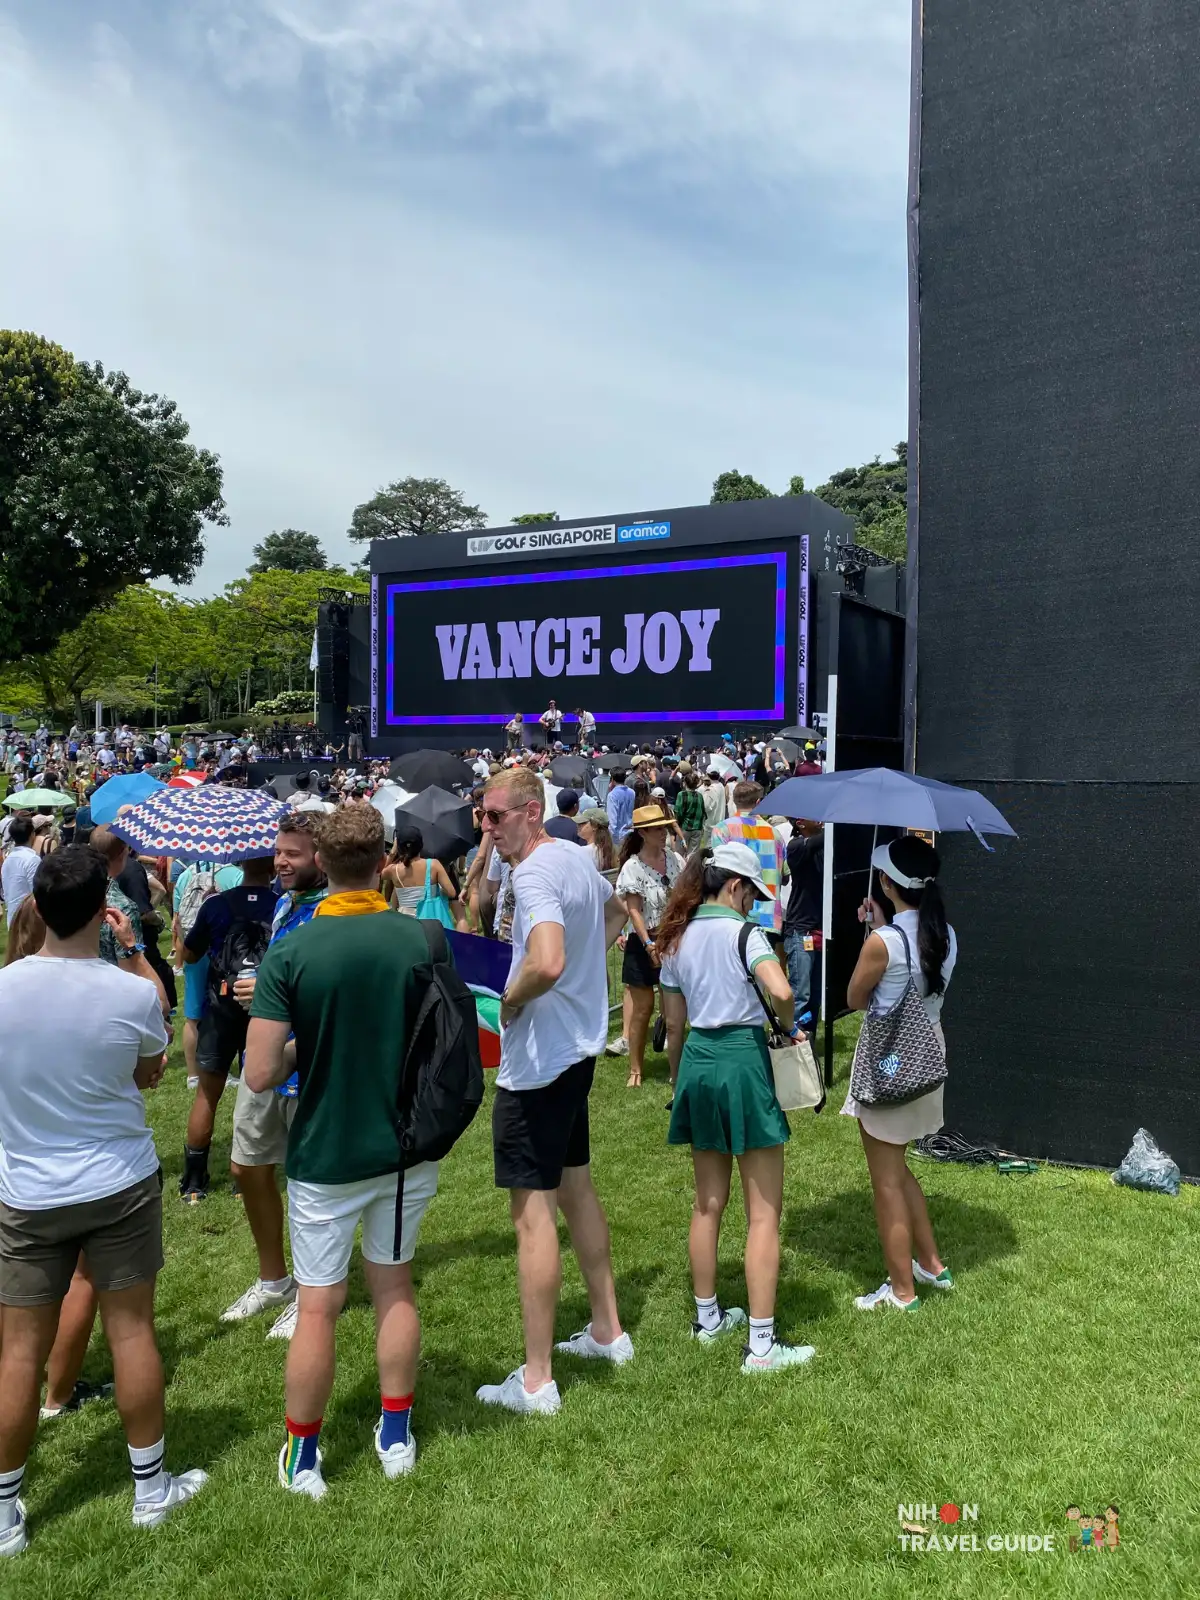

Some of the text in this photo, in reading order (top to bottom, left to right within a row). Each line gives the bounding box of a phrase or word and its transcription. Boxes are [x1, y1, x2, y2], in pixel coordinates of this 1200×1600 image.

[529, 527, 612, 547] SINGAPORE
[620, 525, 668, 539] aramco
[435, 608, 720, 680] VANCE JOY
[757, 1331, 771, 1339] alo
